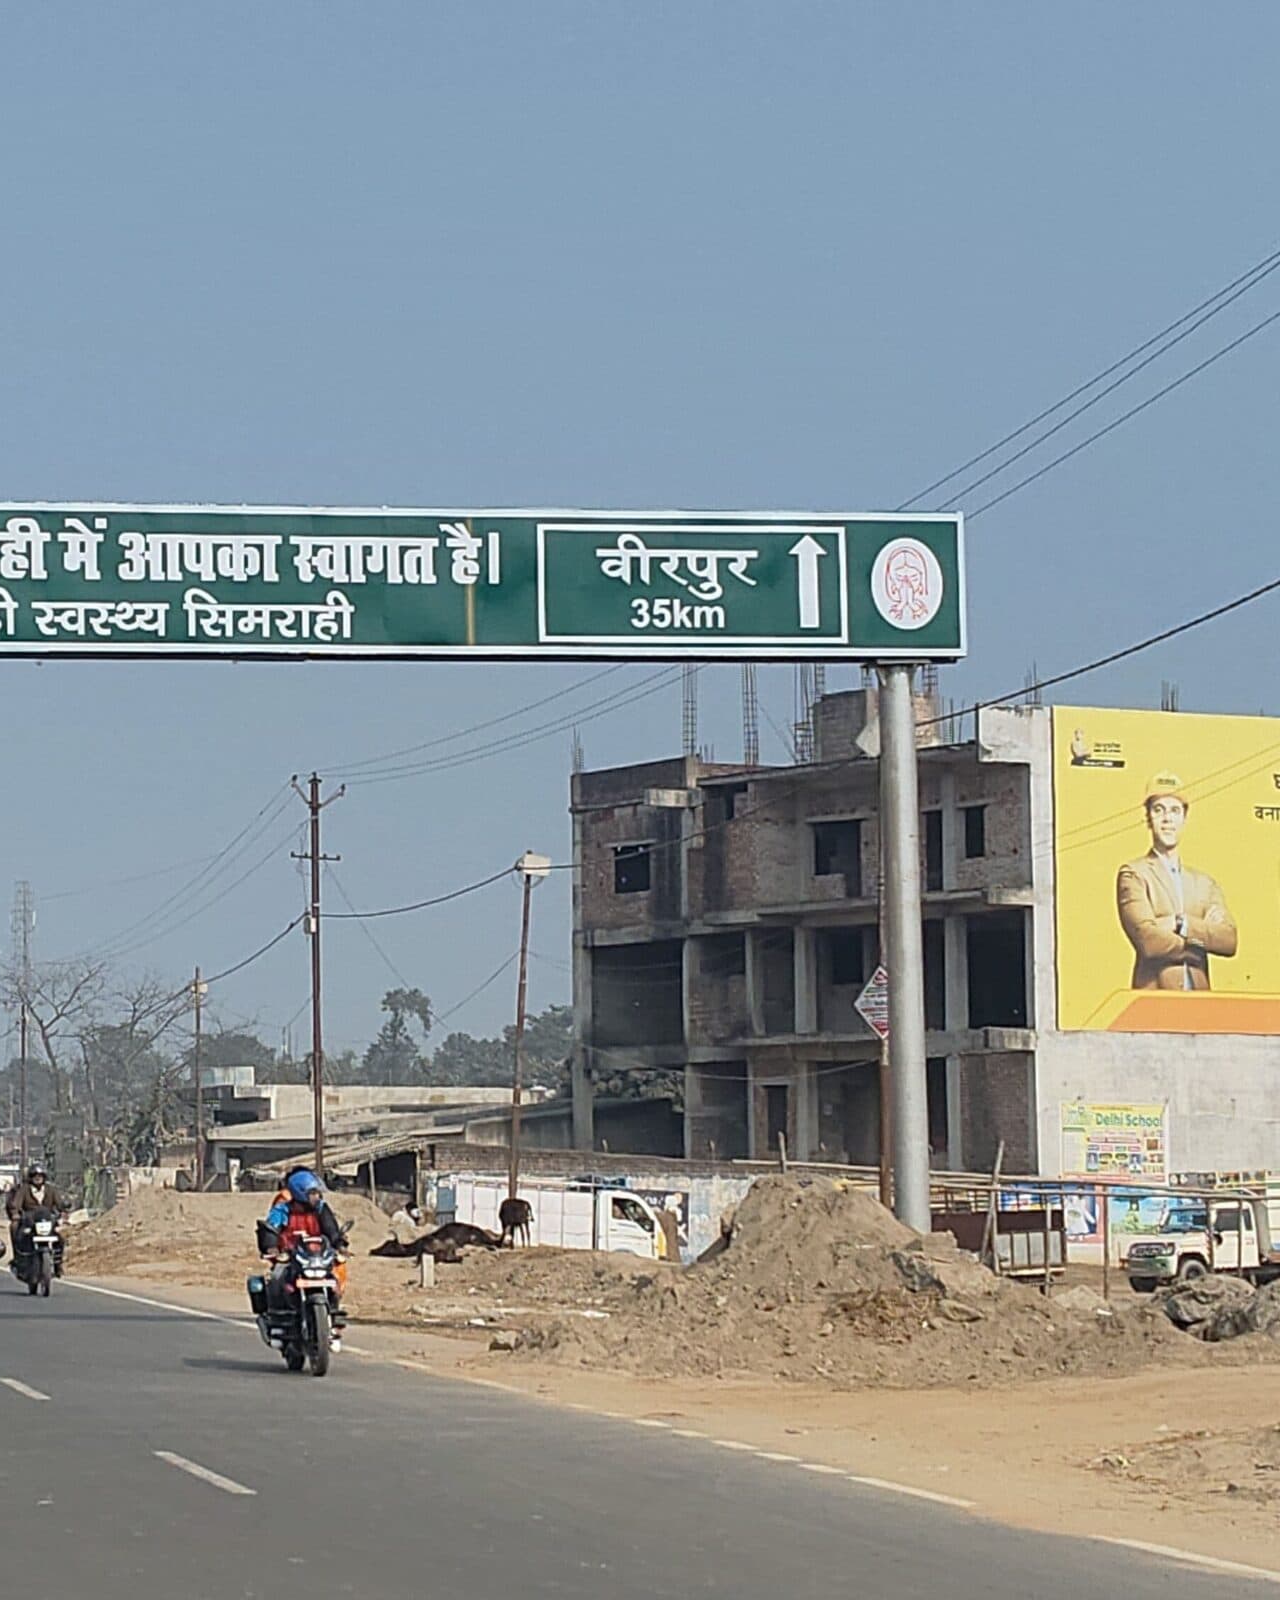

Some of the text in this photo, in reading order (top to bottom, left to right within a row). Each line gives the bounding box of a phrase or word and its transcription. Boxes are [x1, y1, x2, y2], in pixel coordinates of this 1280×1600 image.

[58, 517, 108, 581] में
[117, 531, 283, 583] आपका
[289, 534, 440, 585] स्वागत
[595, 533, 759, 601] वीरपुर
[31, 600, 170, 637] स्वस्थ्य
[182, 587, 356, 641] सिमराही
[630, 598, 726, 629] 35km
